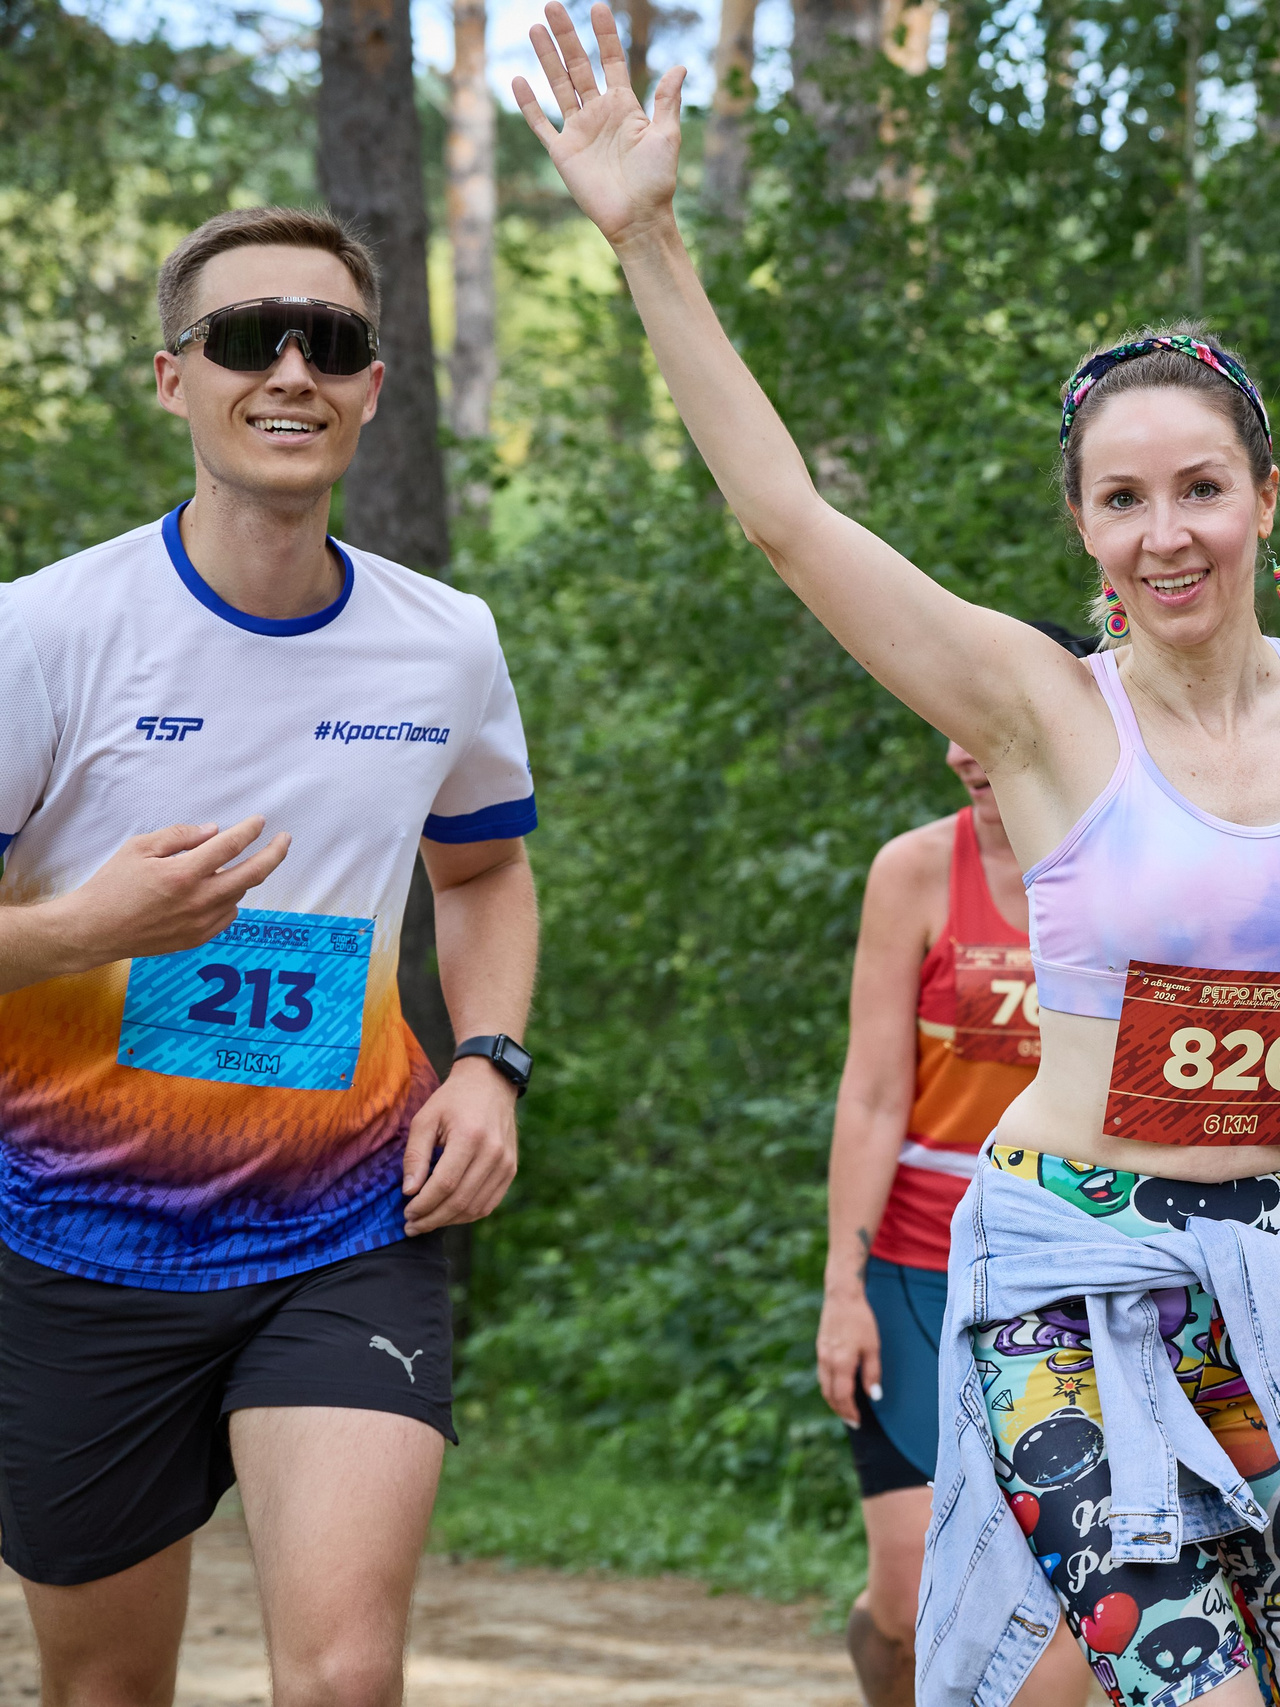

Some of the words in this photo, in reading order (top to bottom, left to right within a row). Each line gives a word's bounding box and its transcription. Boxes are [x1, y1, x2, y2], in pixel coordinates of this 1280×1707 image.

[314, 720, 450, 745] #КроссПоход
[222, 922, 260, 938] ЕТРО
[262, 924, 310, 942] КРОСС
[1142, 977, 1150, 986] 9
[1150, 979, 1192, 993] августа
[1201, 985, 1250, 1001] РЕТРО
[187, 962, 317, 1033] 213
[1153, 991, 1177, 1002] 2026
[1199, 997, 1210, 1005] ко
[217, 1050, 241, 1070] 12
[1203, 1114, 1221, 1135] 6
